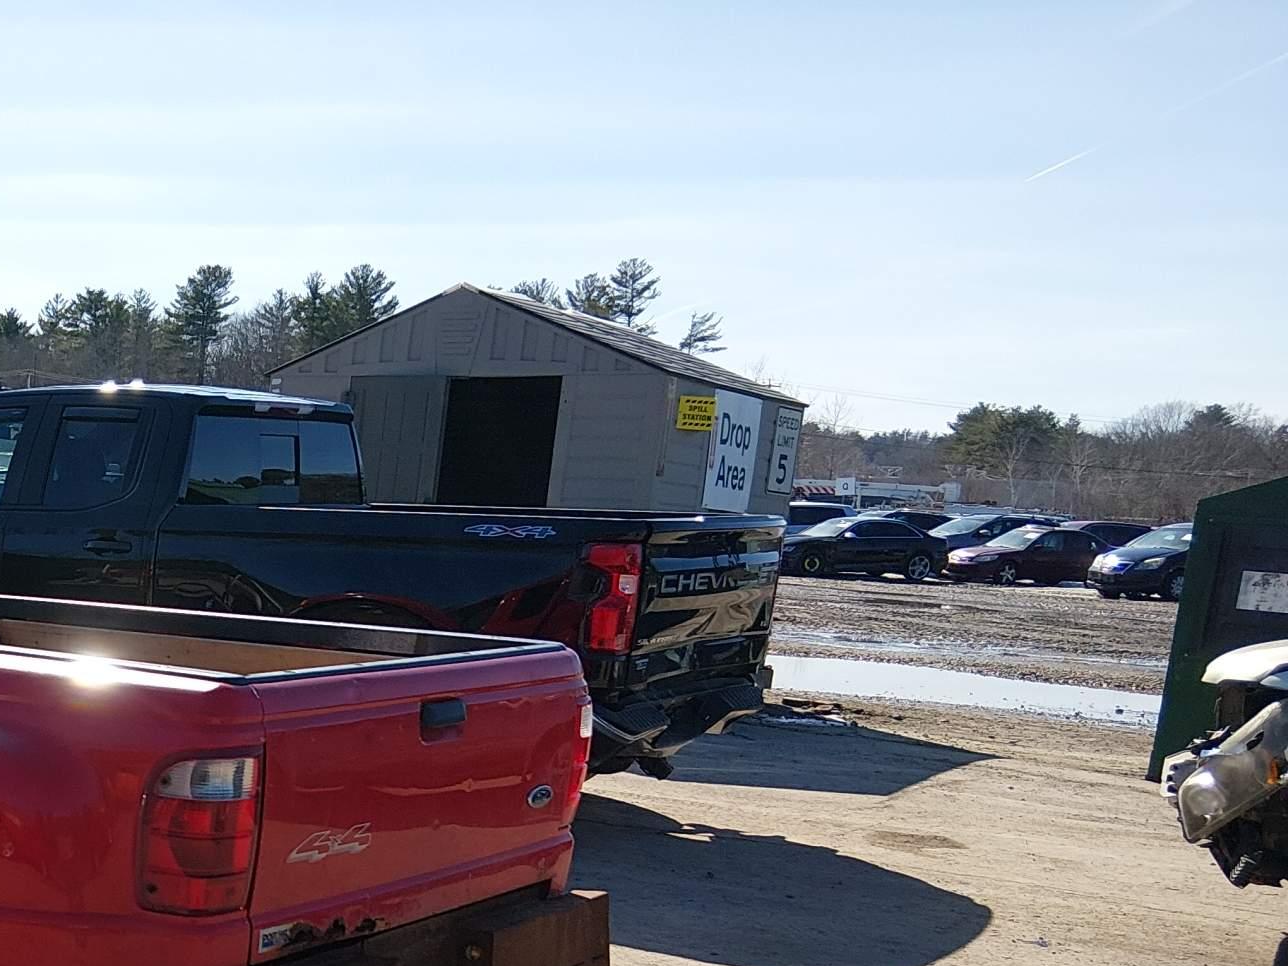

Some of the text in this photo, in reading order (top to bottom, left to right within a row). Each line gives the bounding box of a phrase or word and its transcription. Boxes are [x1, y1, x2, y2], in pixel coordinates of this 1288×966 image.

[682, 413, 712, 421] STATION
[777, 415, 799, 430] SPEED
[720, 412, 751, 456] Drop
[777, 433, 795, 448] LIMIT
[715, 455, 746, 491] Area
[775, 454, 788, 485] 5
[661, 568, 775, 593] CHEVRET
